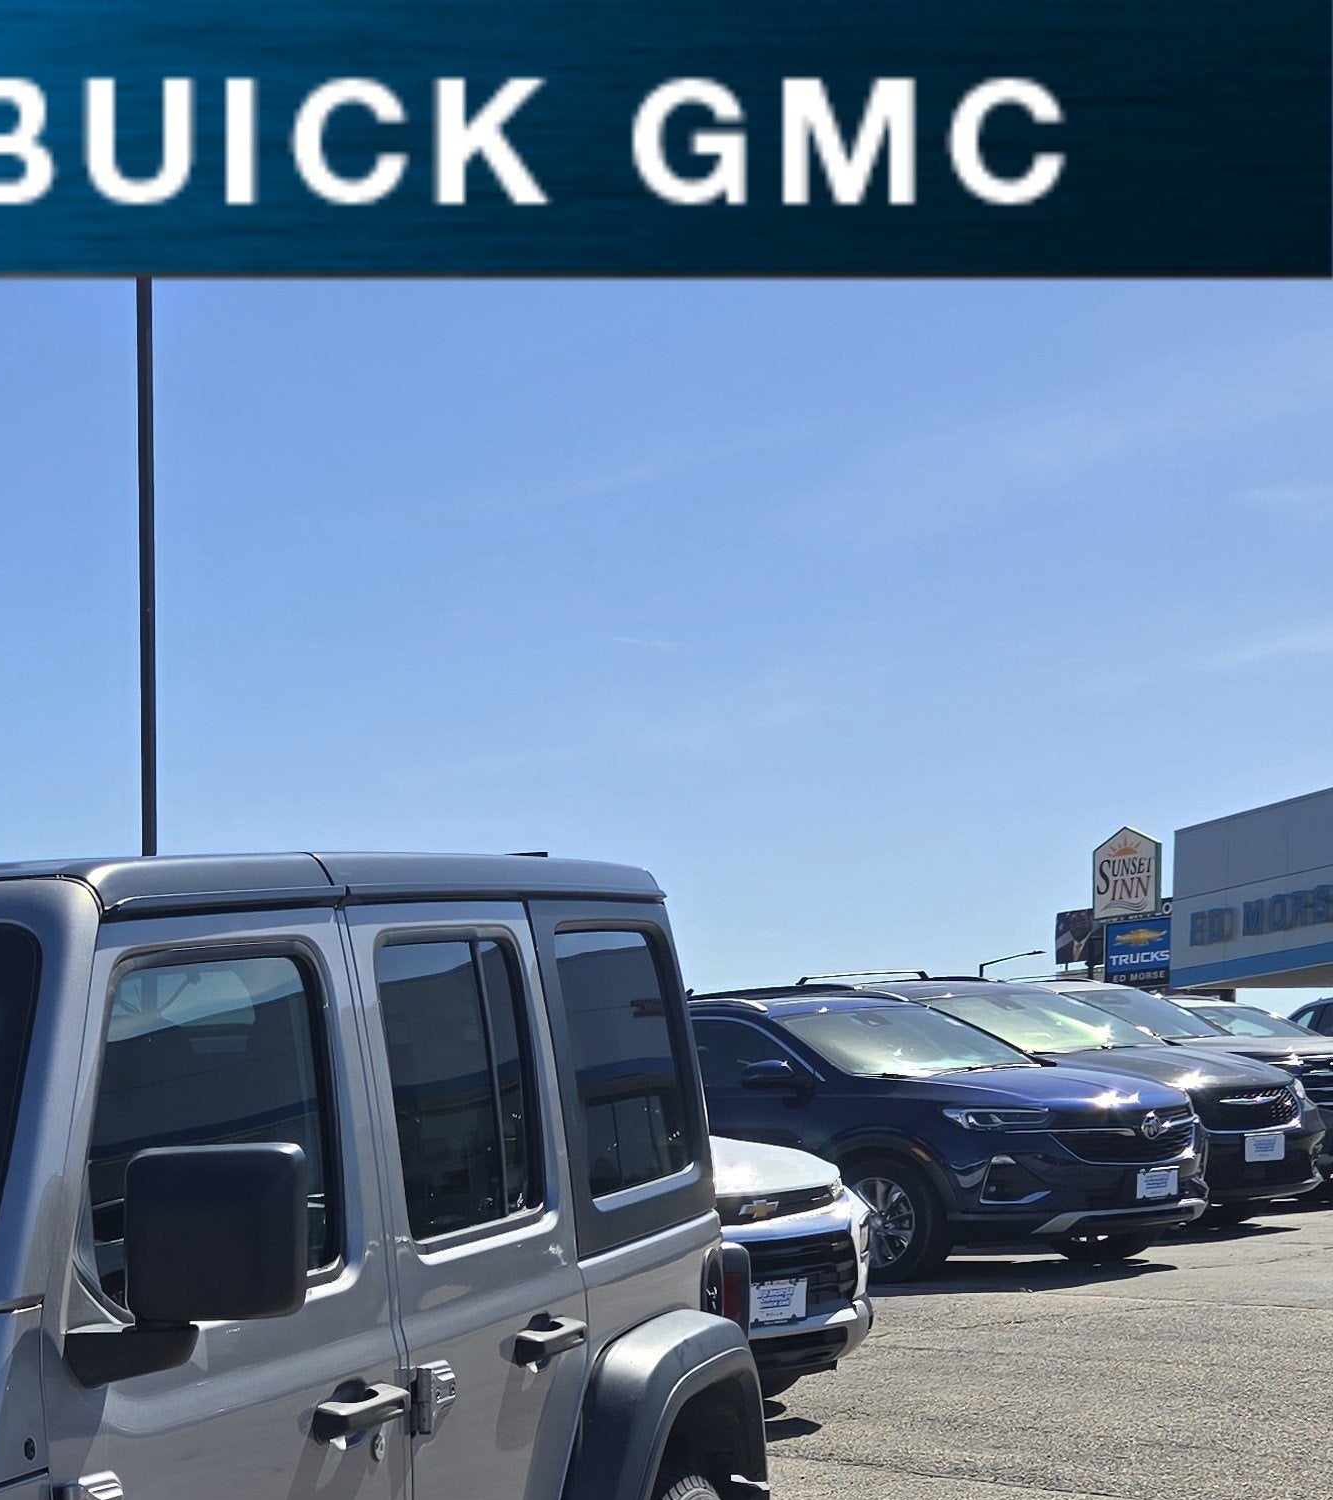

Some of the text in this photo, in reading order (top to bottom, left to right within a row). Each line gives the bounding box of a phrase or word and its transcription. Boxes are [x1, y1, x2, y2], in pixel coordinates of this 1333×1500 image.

[1096, 857, 1153, 895] SUNSET
[1111, 875, 1151, 901] INN
[1190, 908, 1229, 946] ED
[1109, 950, 1170, 966] TRUCKS
[1113, 970, 1165, 983] ED MORSE
